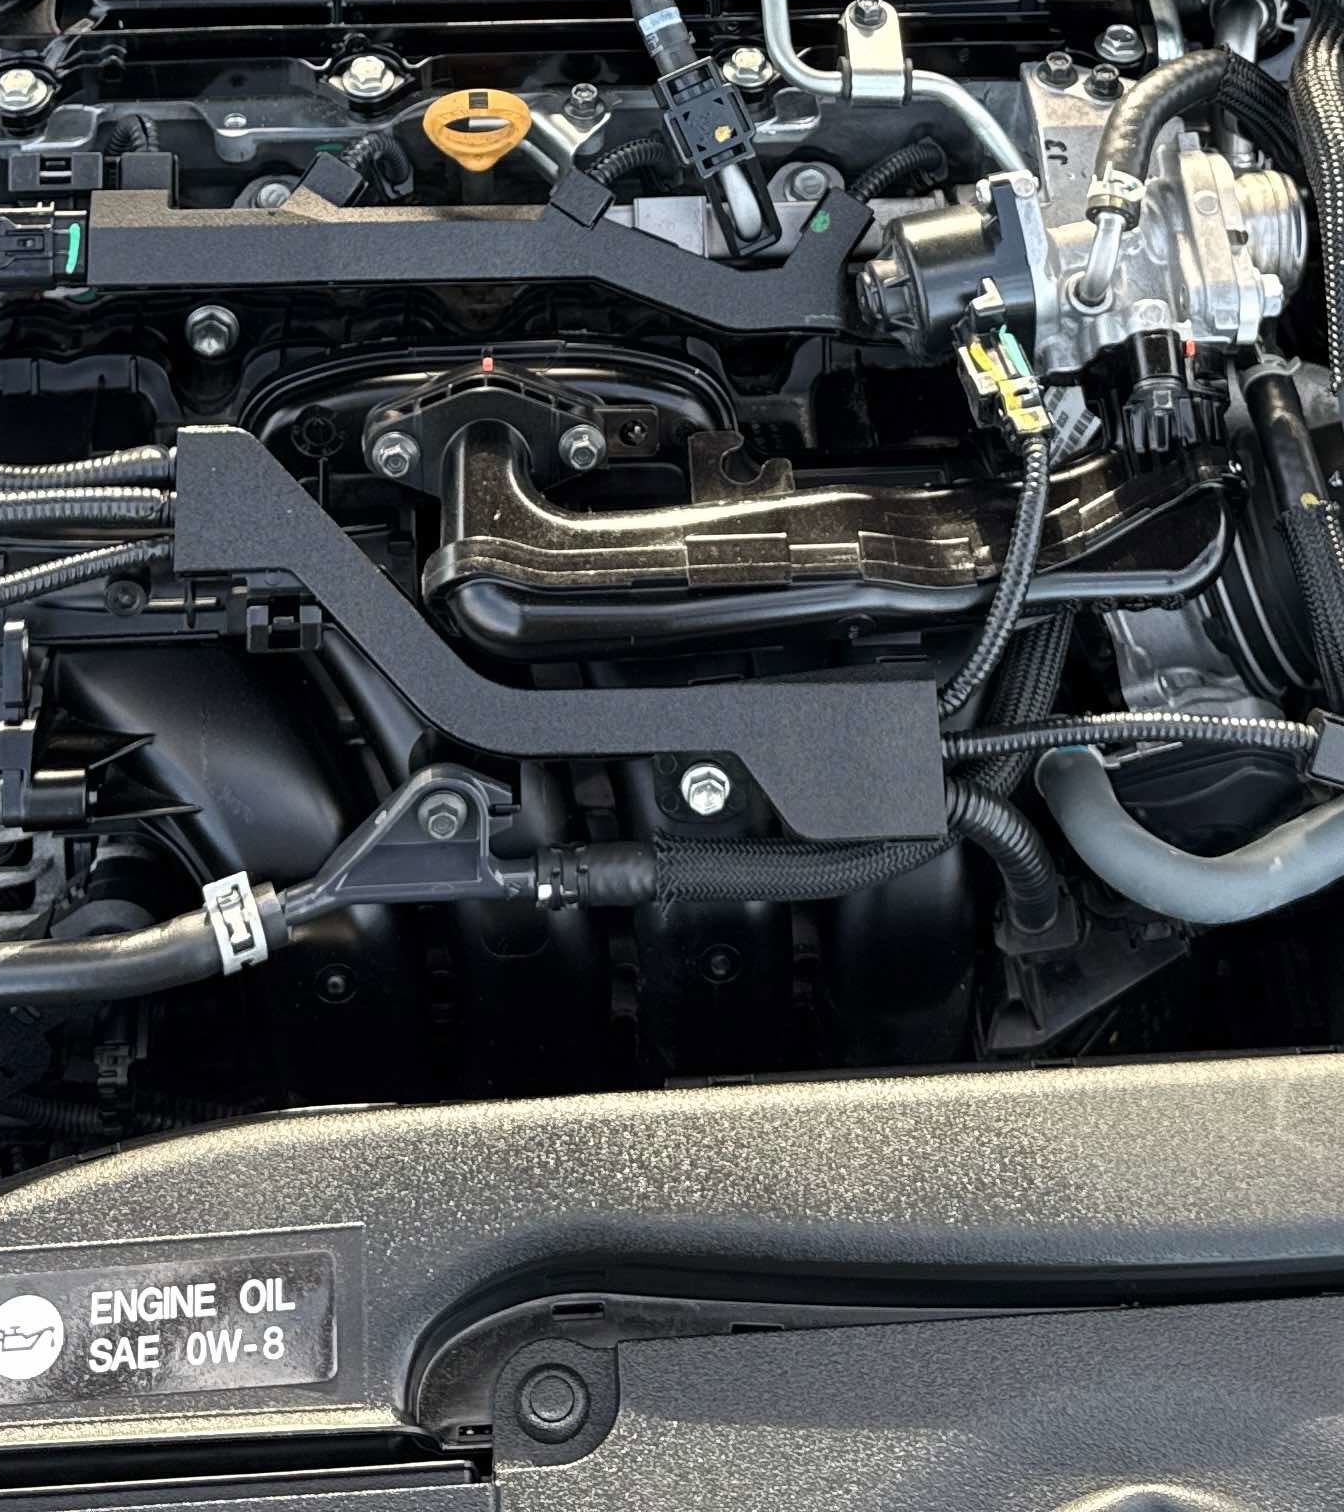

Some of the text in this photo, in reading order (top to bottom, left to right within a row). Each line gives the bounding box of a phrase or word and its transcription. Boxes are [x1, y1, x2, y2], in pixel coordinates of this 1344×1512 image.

[89, 1277, 296, 1325] ENGINE OIL
[88, 1325, 286, 1373] SAE 0W-8
